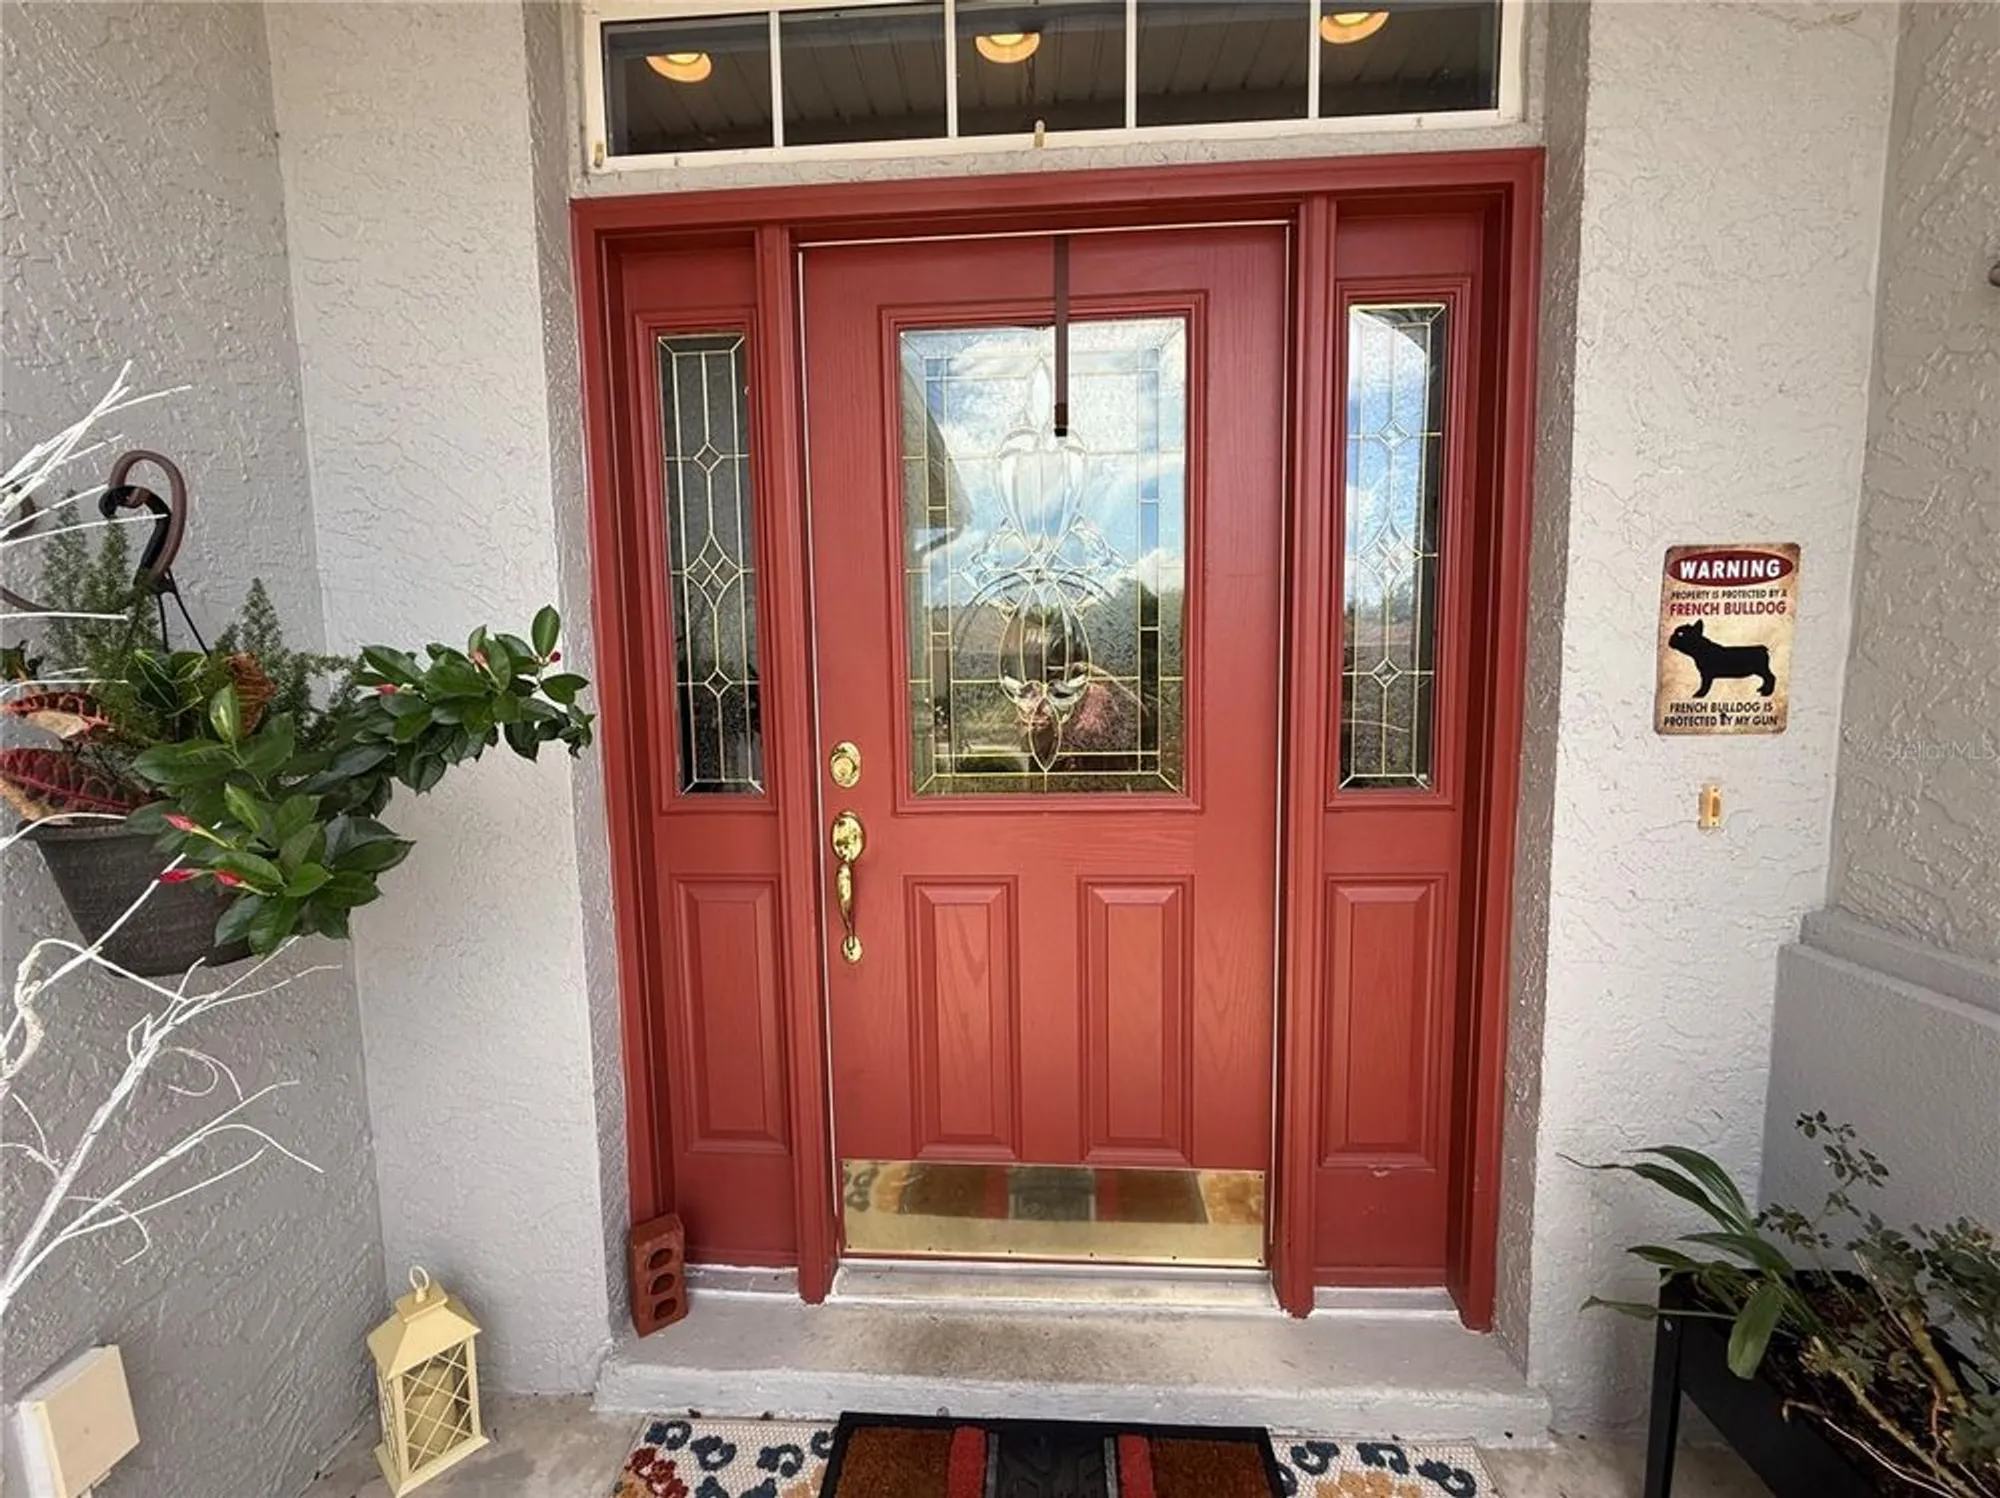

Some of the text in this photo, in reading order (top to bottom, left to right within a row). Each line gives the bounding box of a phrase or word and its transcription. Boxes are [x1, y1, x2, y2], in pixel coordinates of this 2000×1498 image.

[1680, 560, 1780, 579] WARNING
[1671, 588, 1787, 600] PROPERTY IS PROTECTED BY A
[1670, 601, 1786, 616] FRENCH BULLDOG
[1670, 702, 1773, 713] FRENCH BULLDOG IS
[1664, 715, 1778, 727] PROTECTED BY MY GUN
